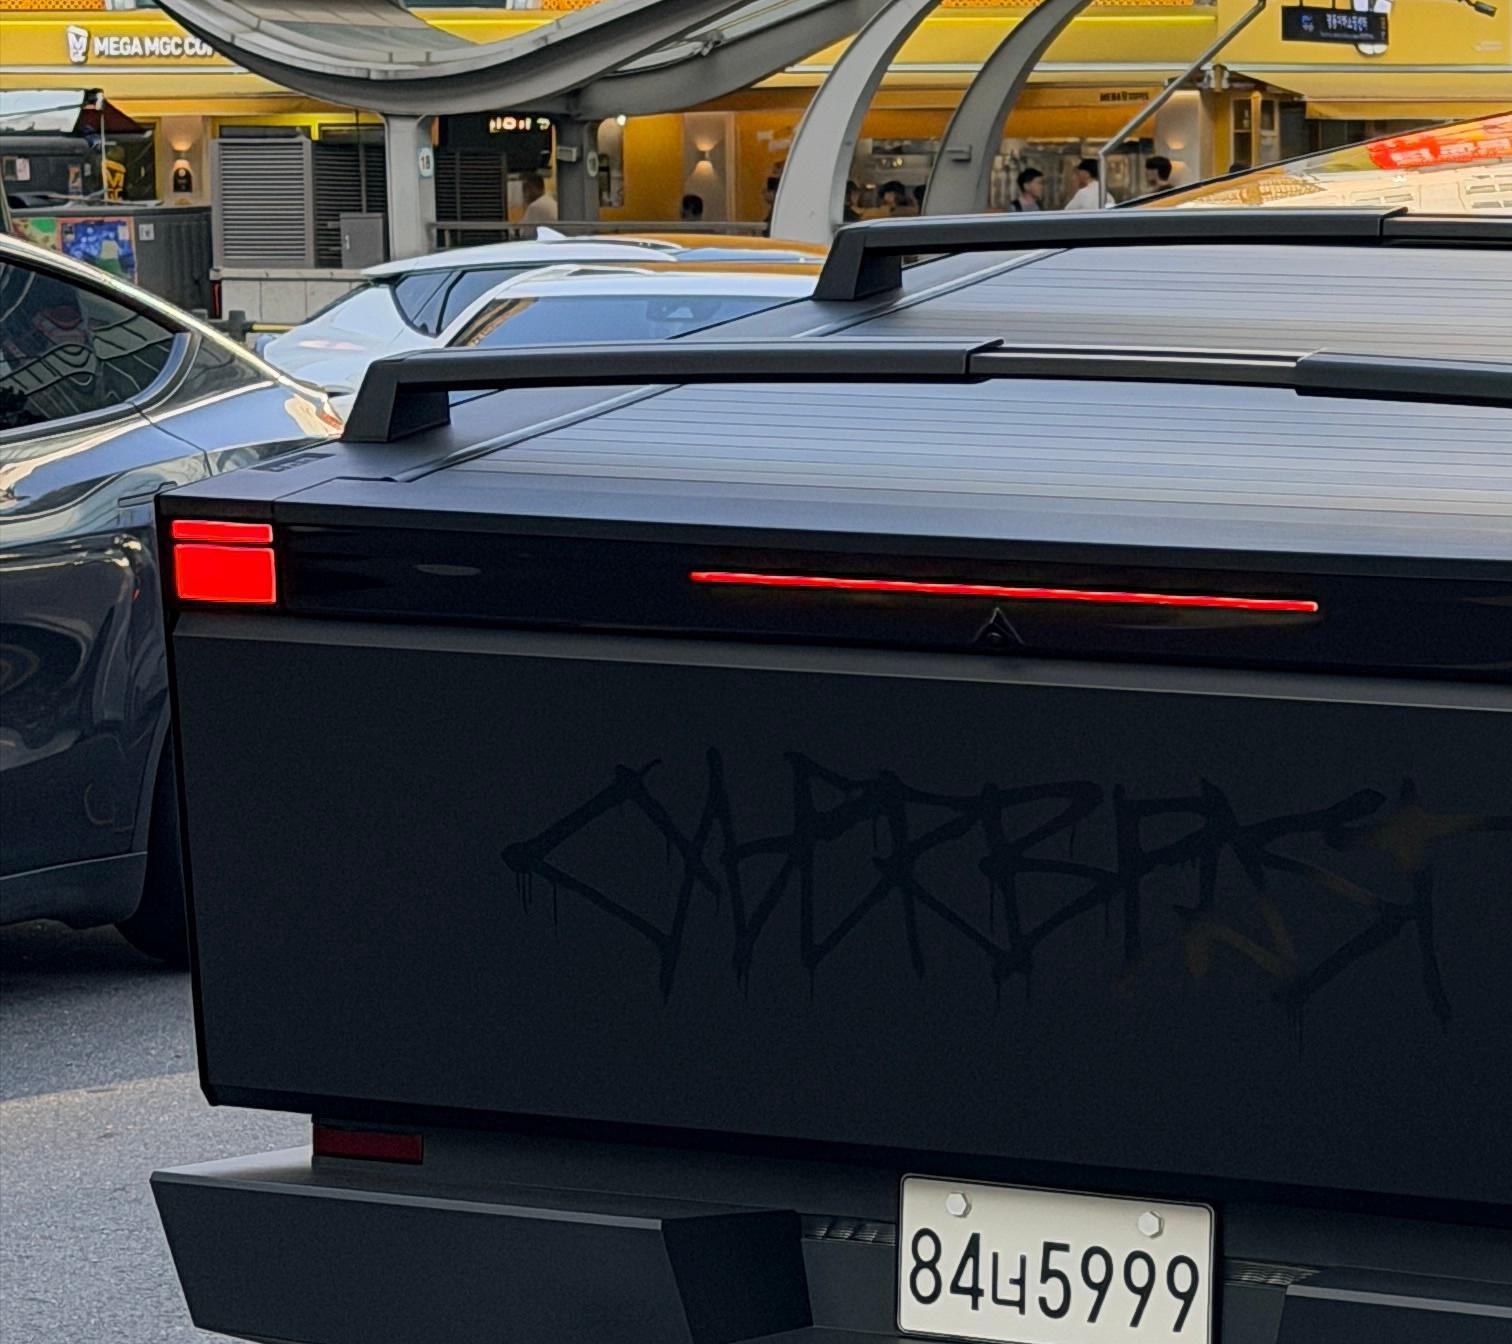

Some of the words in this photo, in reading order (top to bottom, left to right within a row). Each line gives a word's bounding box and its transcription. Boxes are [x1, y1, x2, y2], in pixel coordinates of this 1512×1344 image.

[94, 36, 144, 56] MEGA
[145, 36, 182, 55] MGC
[909, 1227, 1200, 1333] 84너5999
